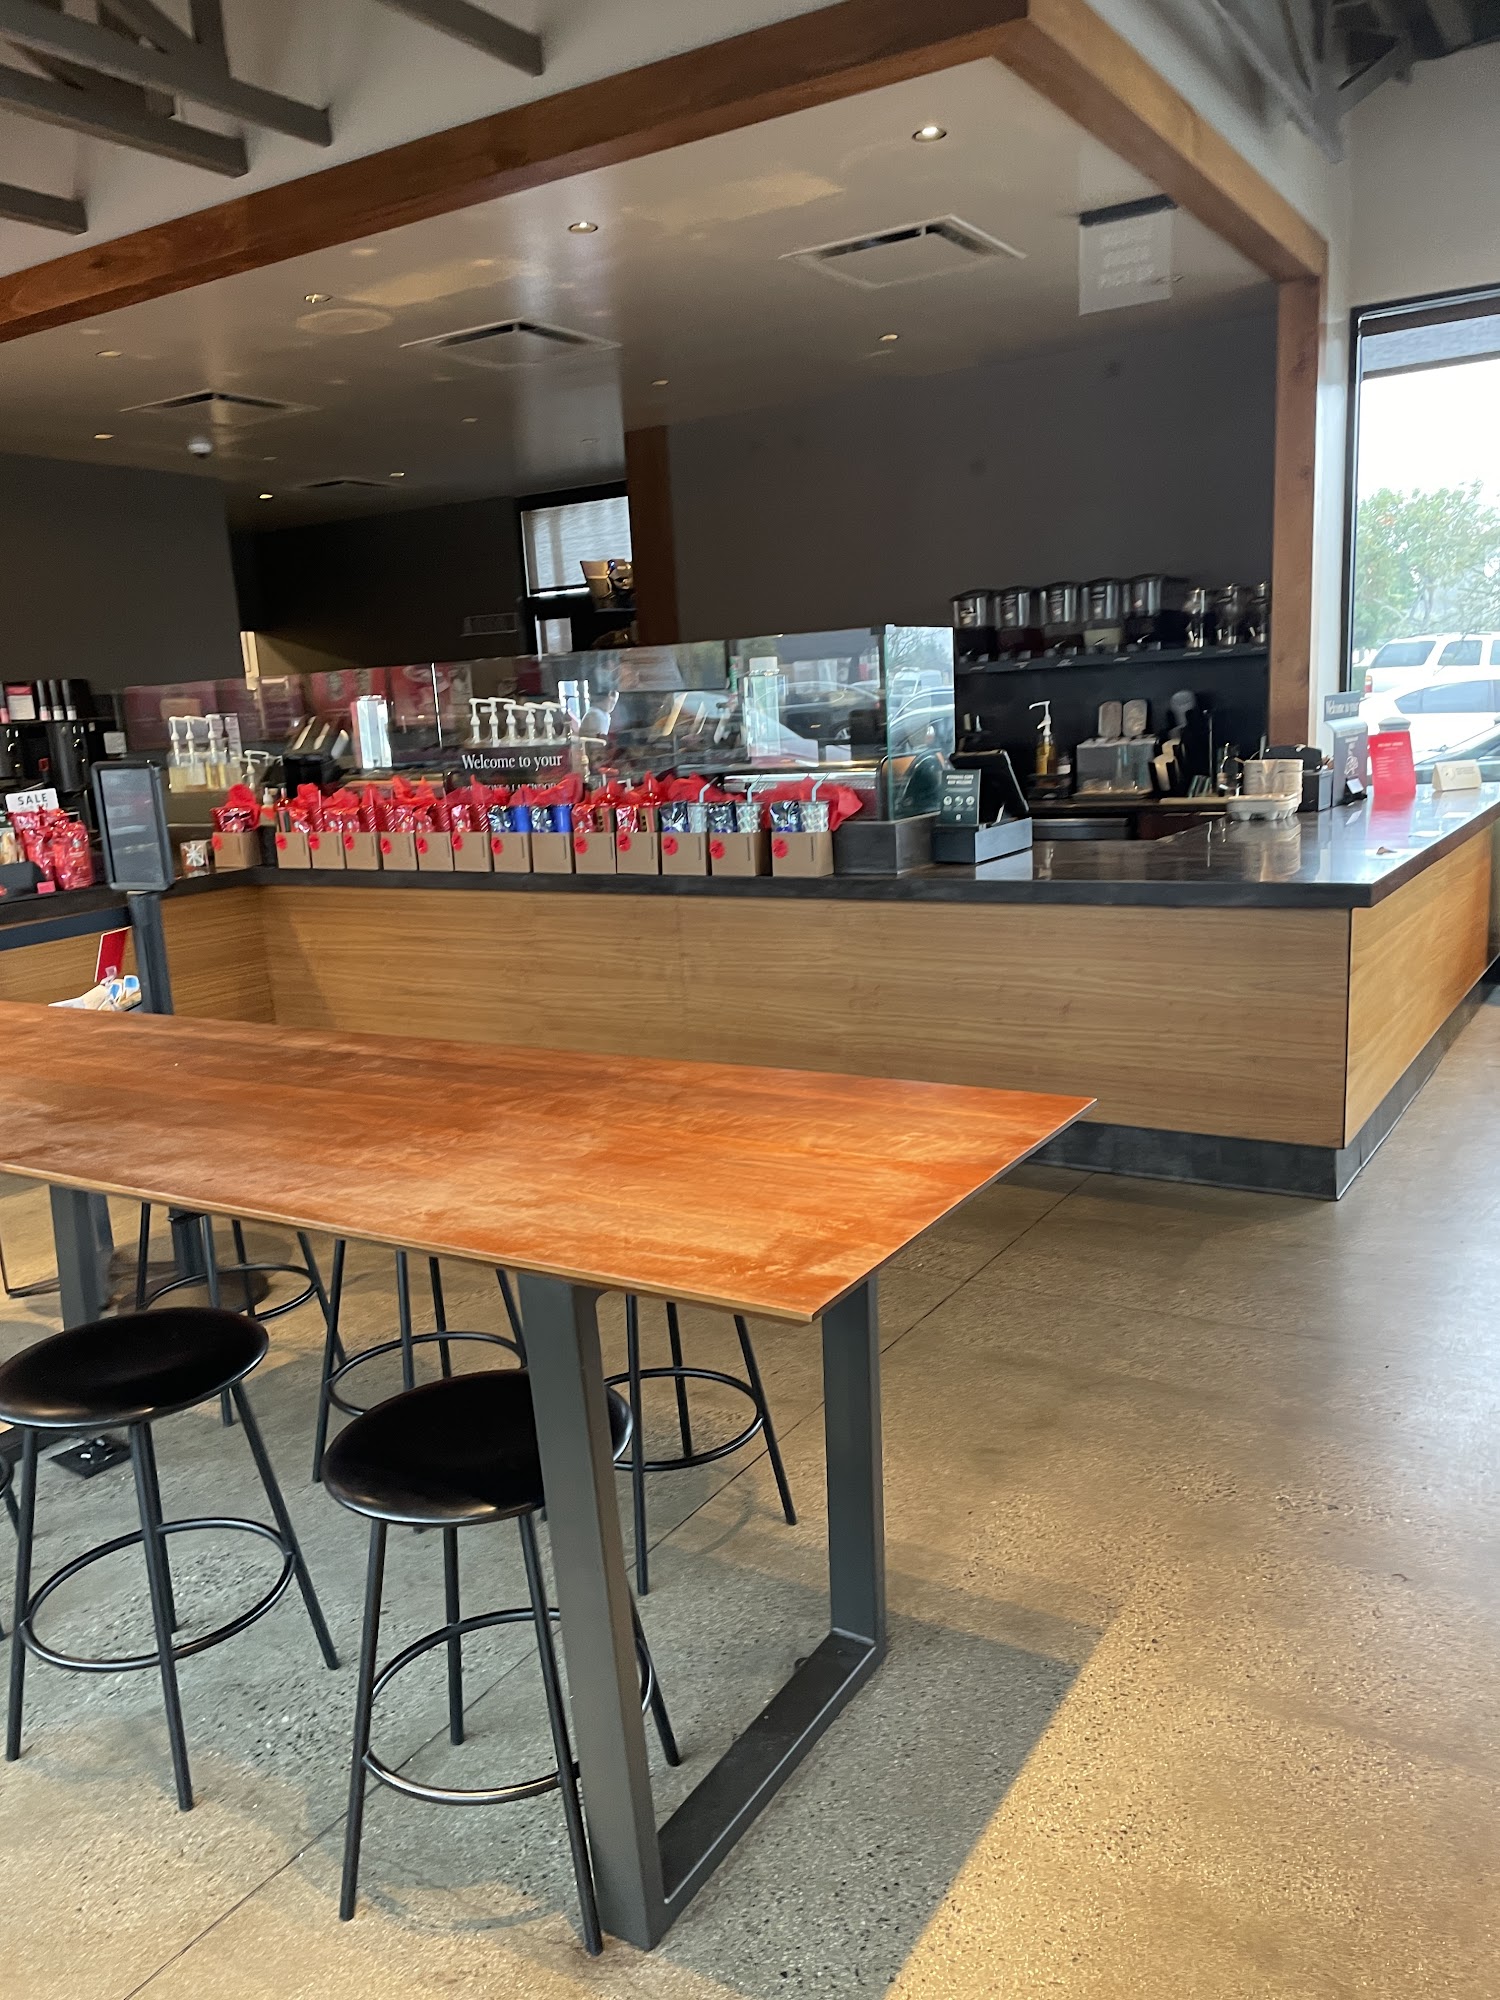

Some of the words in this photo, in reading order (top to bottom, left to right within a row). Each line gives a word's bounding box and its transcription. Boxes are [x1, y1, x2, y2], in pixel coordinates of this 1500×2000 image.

[462, 754, 516, 770] Welcome
[519, 755, 531, 768] to
[533, 754, 564, 772] your
[18, 793, 48, 804] SALE
